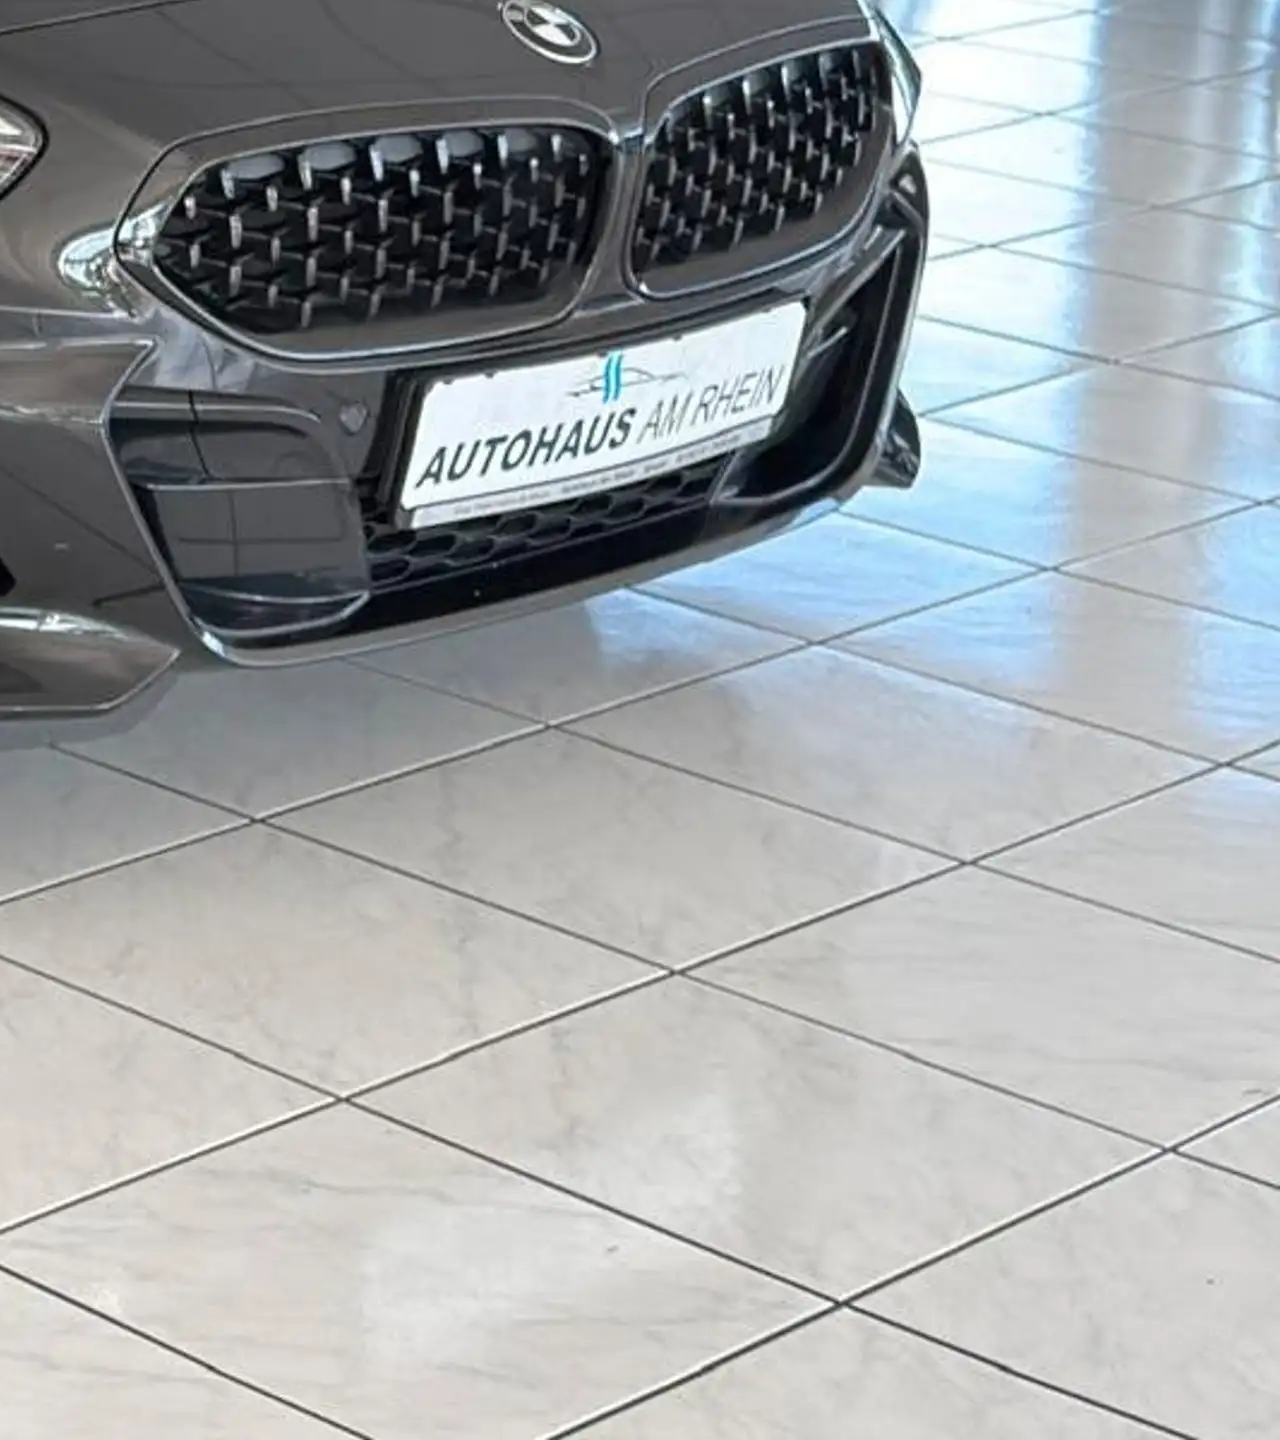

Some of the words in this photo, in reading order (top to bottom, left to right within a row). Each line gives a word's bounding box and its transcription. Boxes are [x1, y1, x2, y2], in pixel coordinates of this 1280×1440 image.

[415, 407, 637, 489] AUTOHAUS
[636, 393, 692, 445] AM
[689, 363, 786, 428] RHEIN
